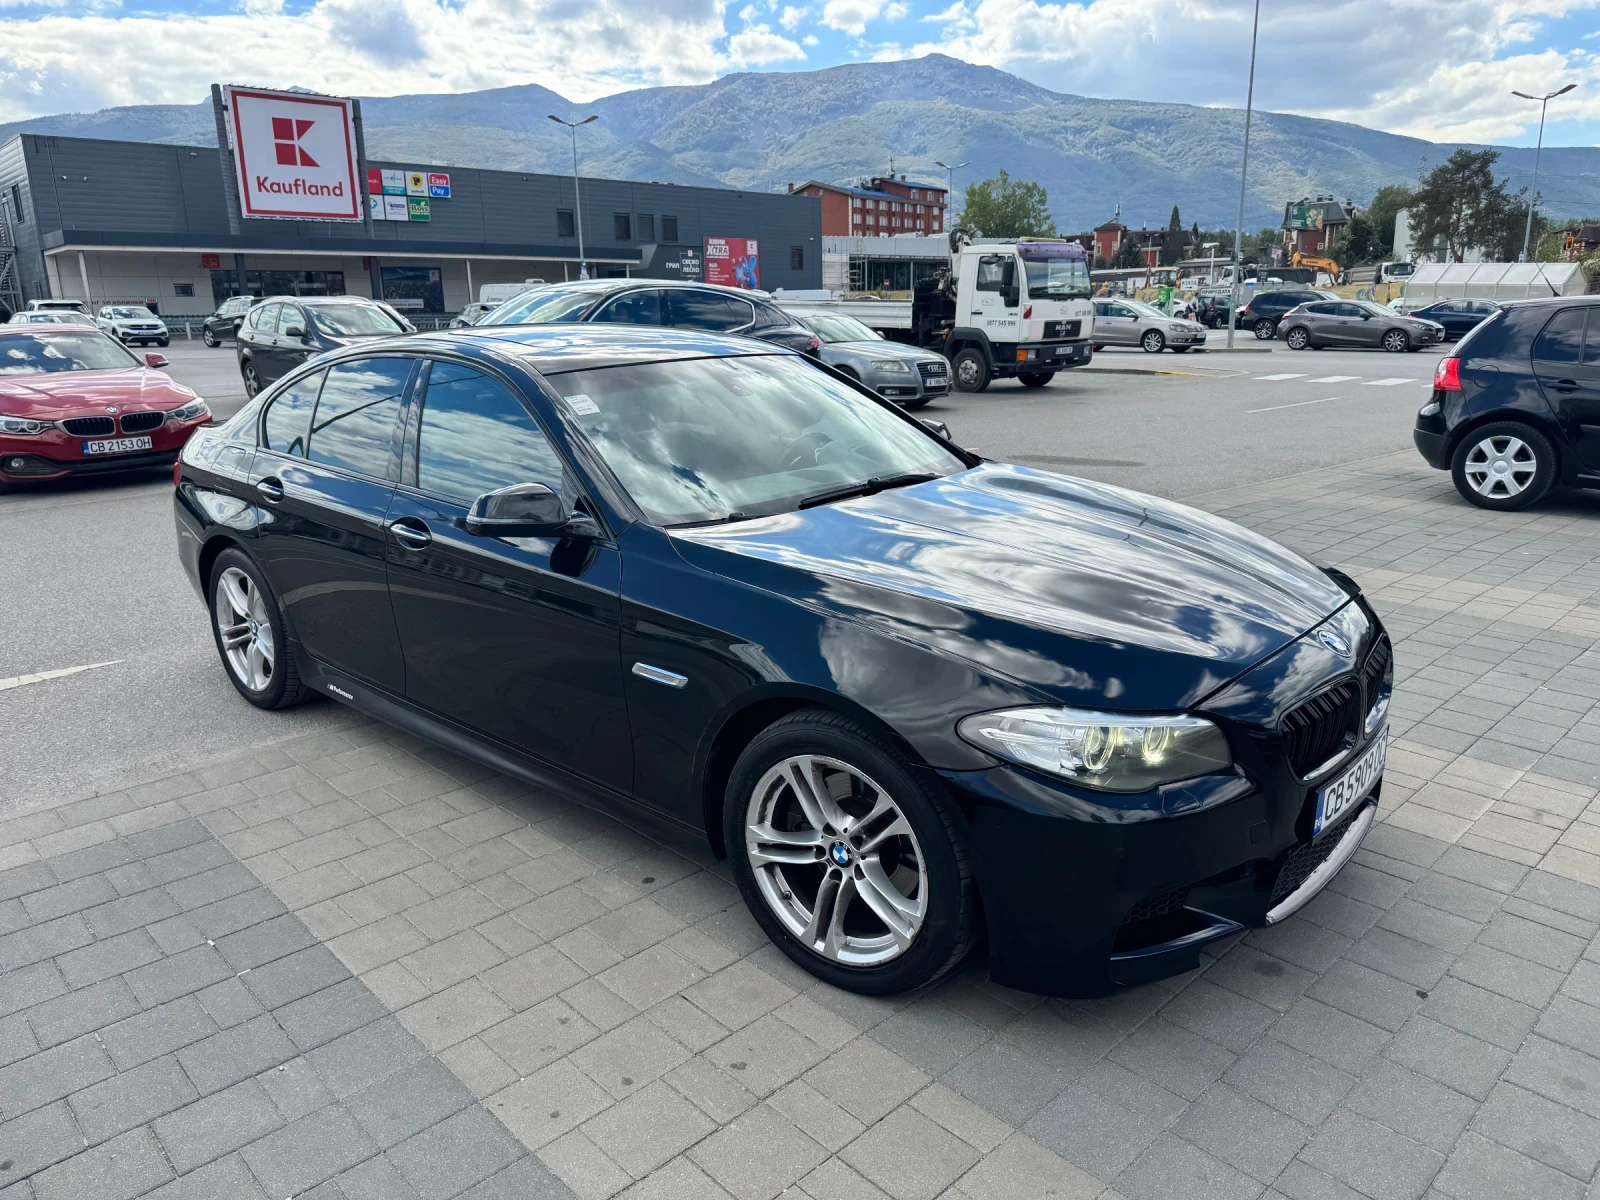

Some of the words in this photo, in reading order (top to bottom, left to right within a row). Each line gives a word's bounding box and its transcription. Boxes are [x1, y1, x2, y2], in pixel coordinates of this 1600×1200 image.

[256, 175, 343, 197] Kaufland
[431, 176, 447, 185] Easy
[432, 187, 445, 196] Pay
[1055, 323, 1072, 331] MAN
[90, 442, 105, 453] CB
[107, 439, 134, 451] 2153
[1325, 780, 1345, 821] CB
[1346, 751, 1374, 804] 5909
